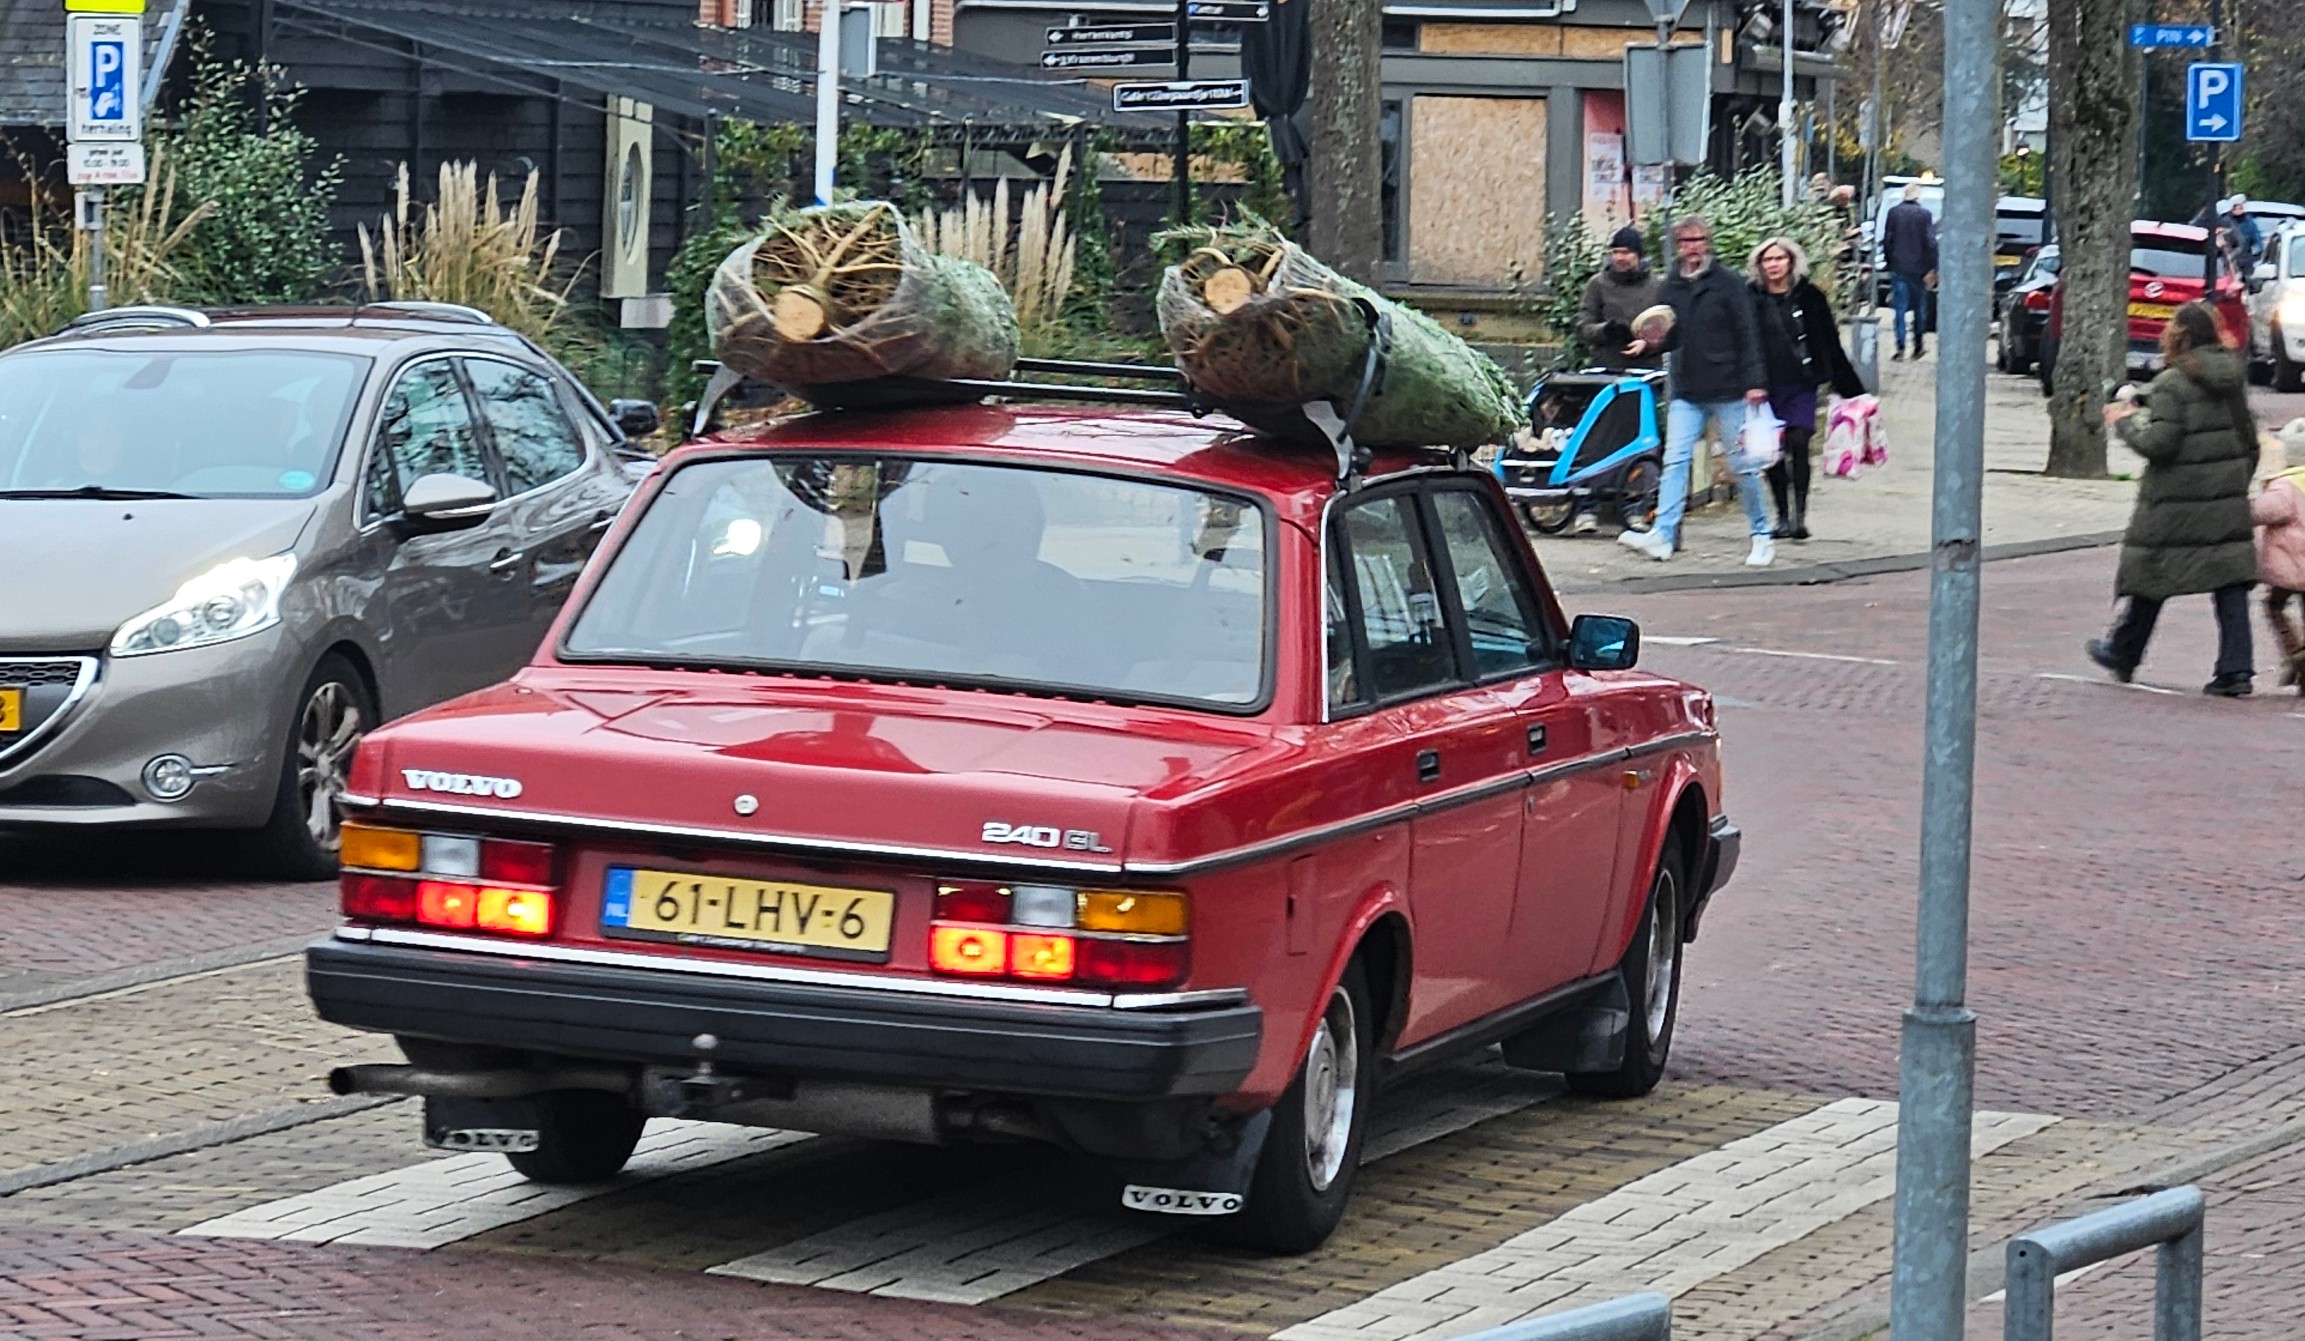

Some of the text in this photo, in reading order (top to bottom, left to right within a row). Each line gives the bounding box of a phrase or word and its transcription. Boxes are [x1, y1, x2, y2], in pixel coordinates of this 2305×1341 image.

[95, 44, 120, 87] P
[2198, 69, 2229, 109] P
[400, 769, 523, 798] VOLVO
[981, 822, 1113, 853] 240 GL
[655, 880, 865, 940] 61-LHV-6
[1129, 1190, 1238, 1211] VOLVO
